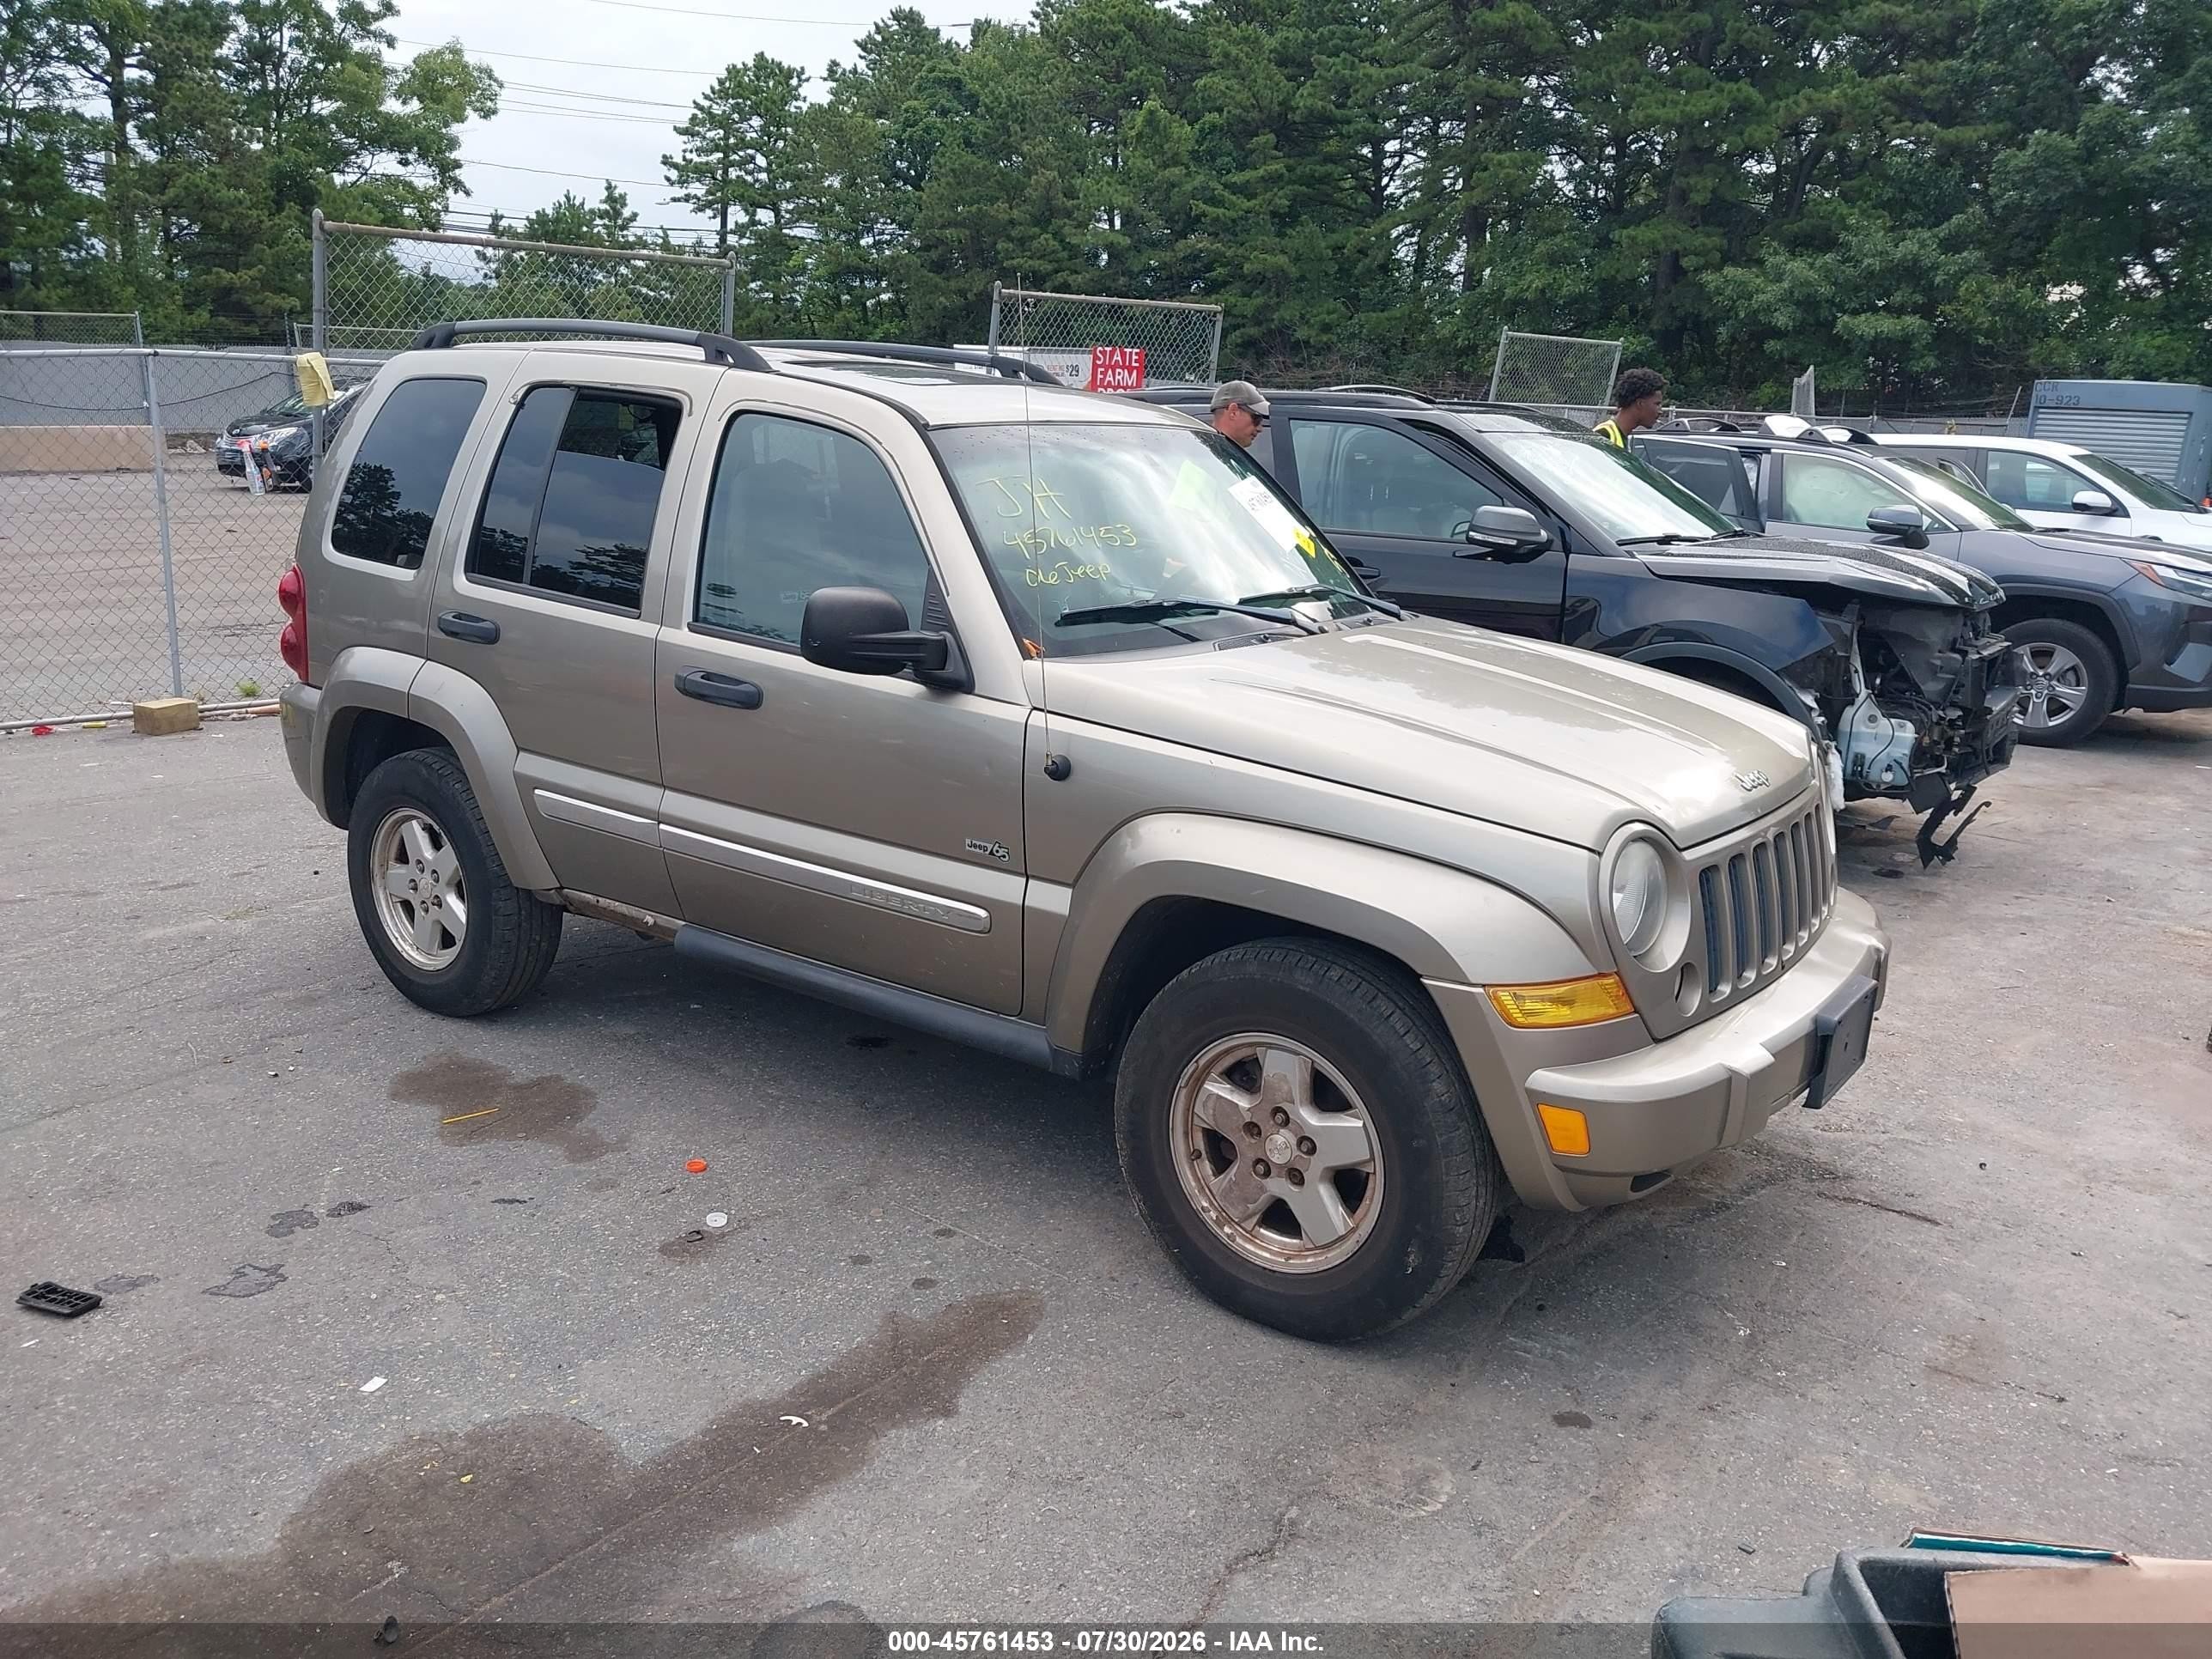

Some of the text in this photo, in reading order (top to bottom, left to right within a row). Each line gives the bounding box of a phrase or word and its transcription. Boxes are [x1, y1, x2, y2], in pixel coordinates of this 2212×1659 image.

[1096, 346, 1140, 367] STATE
[1066, 364, 1079, 377] $29
[1097, 368, 1137, 386] FARM
[2034, 394, 2081, 406] 10-923
[1002, 524, 1137, 559] 45761453
[1734, 769, 1771, 792] Jeep
[967, 841, 1010, 862] Jeep 65
